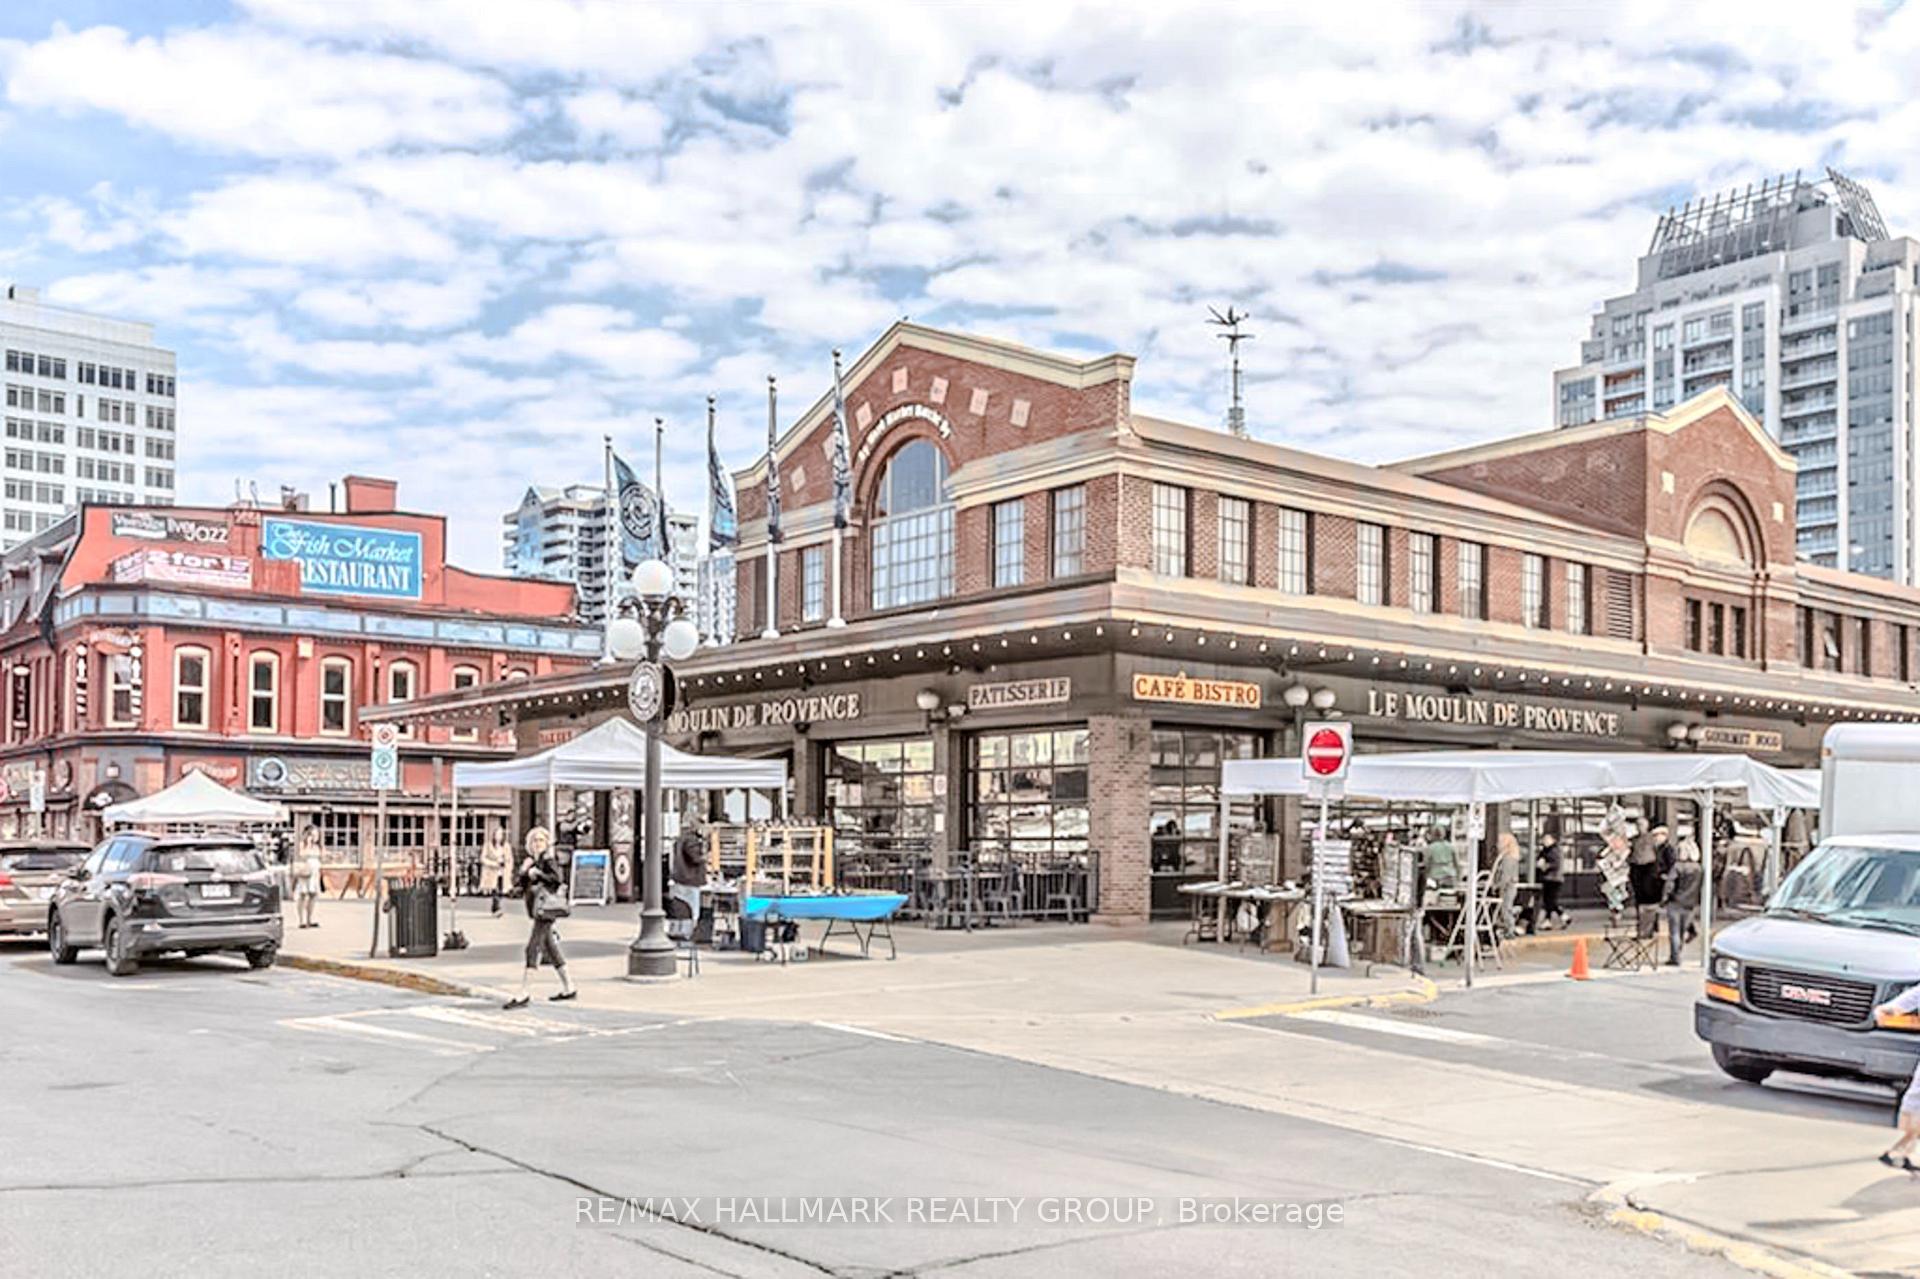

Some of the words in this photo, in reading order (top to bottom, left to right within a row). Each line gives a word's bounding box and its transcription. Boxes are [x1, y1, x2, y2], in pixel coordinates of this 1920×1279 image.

[270, 530, 329, 559] Fish
[333, 536, 413, 563] Market
[293, 557, 412, 591] RESTAURANT
[971, 681, 1068, 705] PATISSERIE
[1193, 683, 1257, 704] BISTRO
[667, 705, 730, 733] MOULIN
[733, 702, 755, 729] DE
[761, 694, 859, 725] PROVENCE
[1368, 690, 1398, 717] LE
[1406, 694, 1488, 725] MOULIN
[1494, 702, 1519, 728] DE
[1524, 705, 1618, 736] PROVENCE
